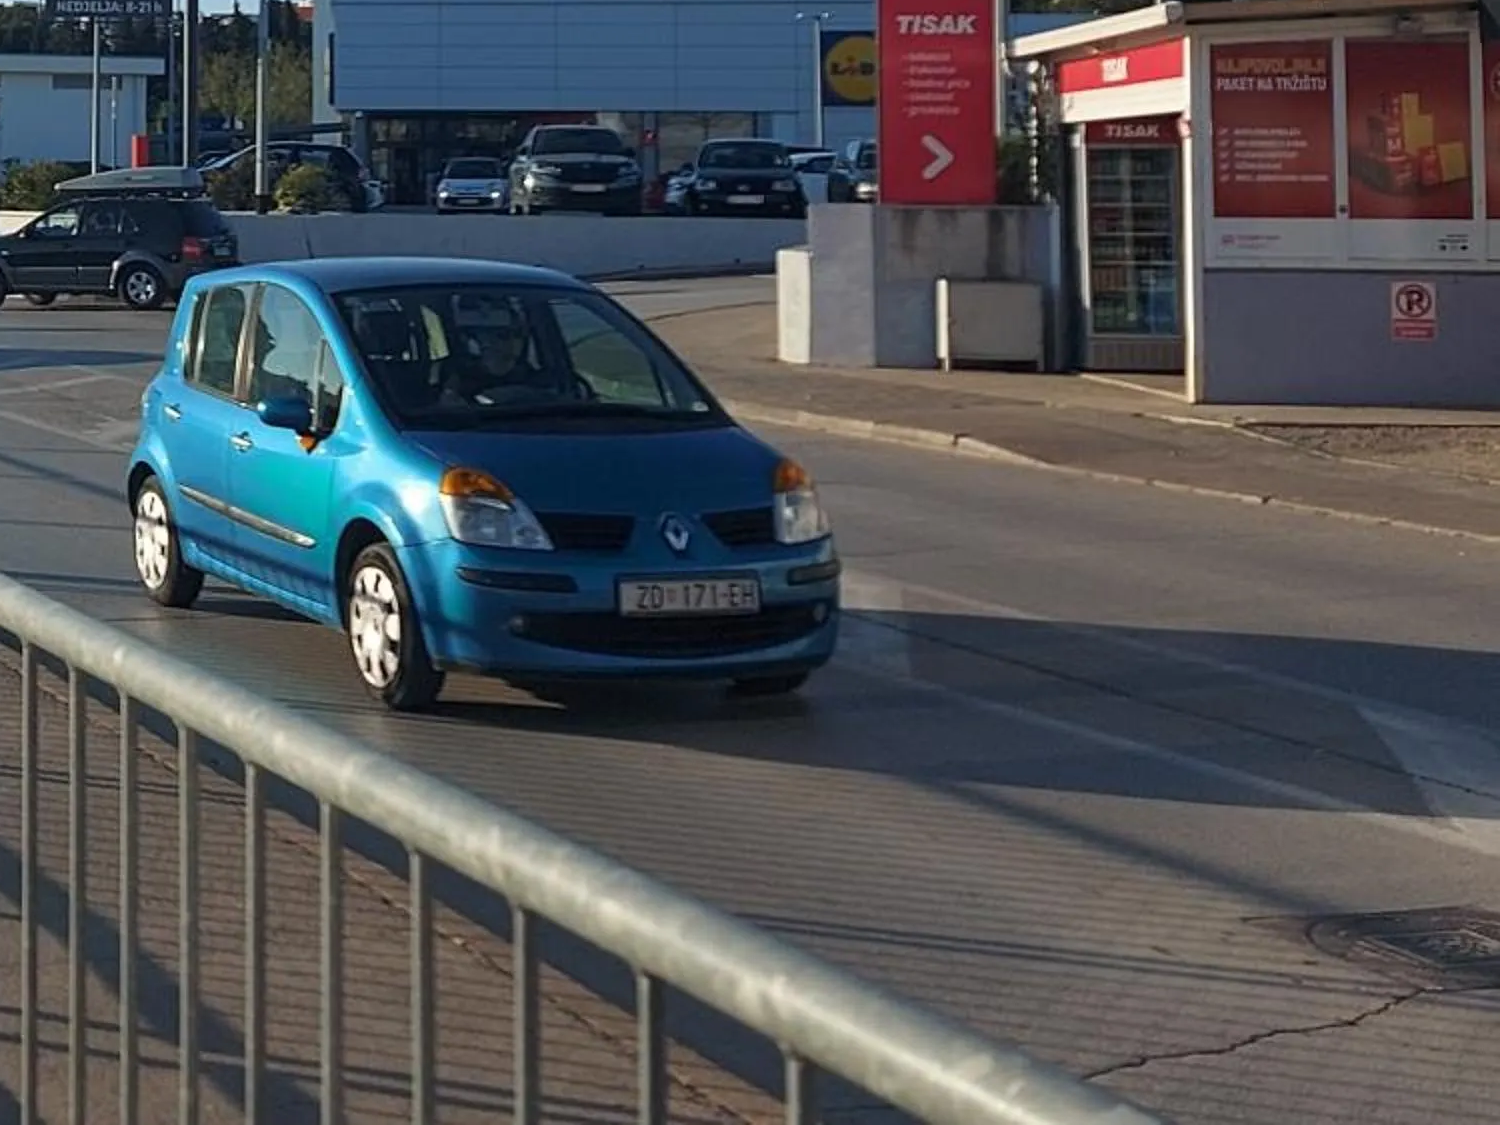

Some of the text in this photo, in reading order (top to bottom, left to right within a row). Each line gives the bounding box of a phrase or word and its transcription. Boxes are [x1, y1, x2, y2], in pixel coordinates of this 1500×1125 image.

[895, 14, 977, 35] TISAK
[1105, 123, 1160, 138] TISAK
[636, 584, 664, 609] ZD
